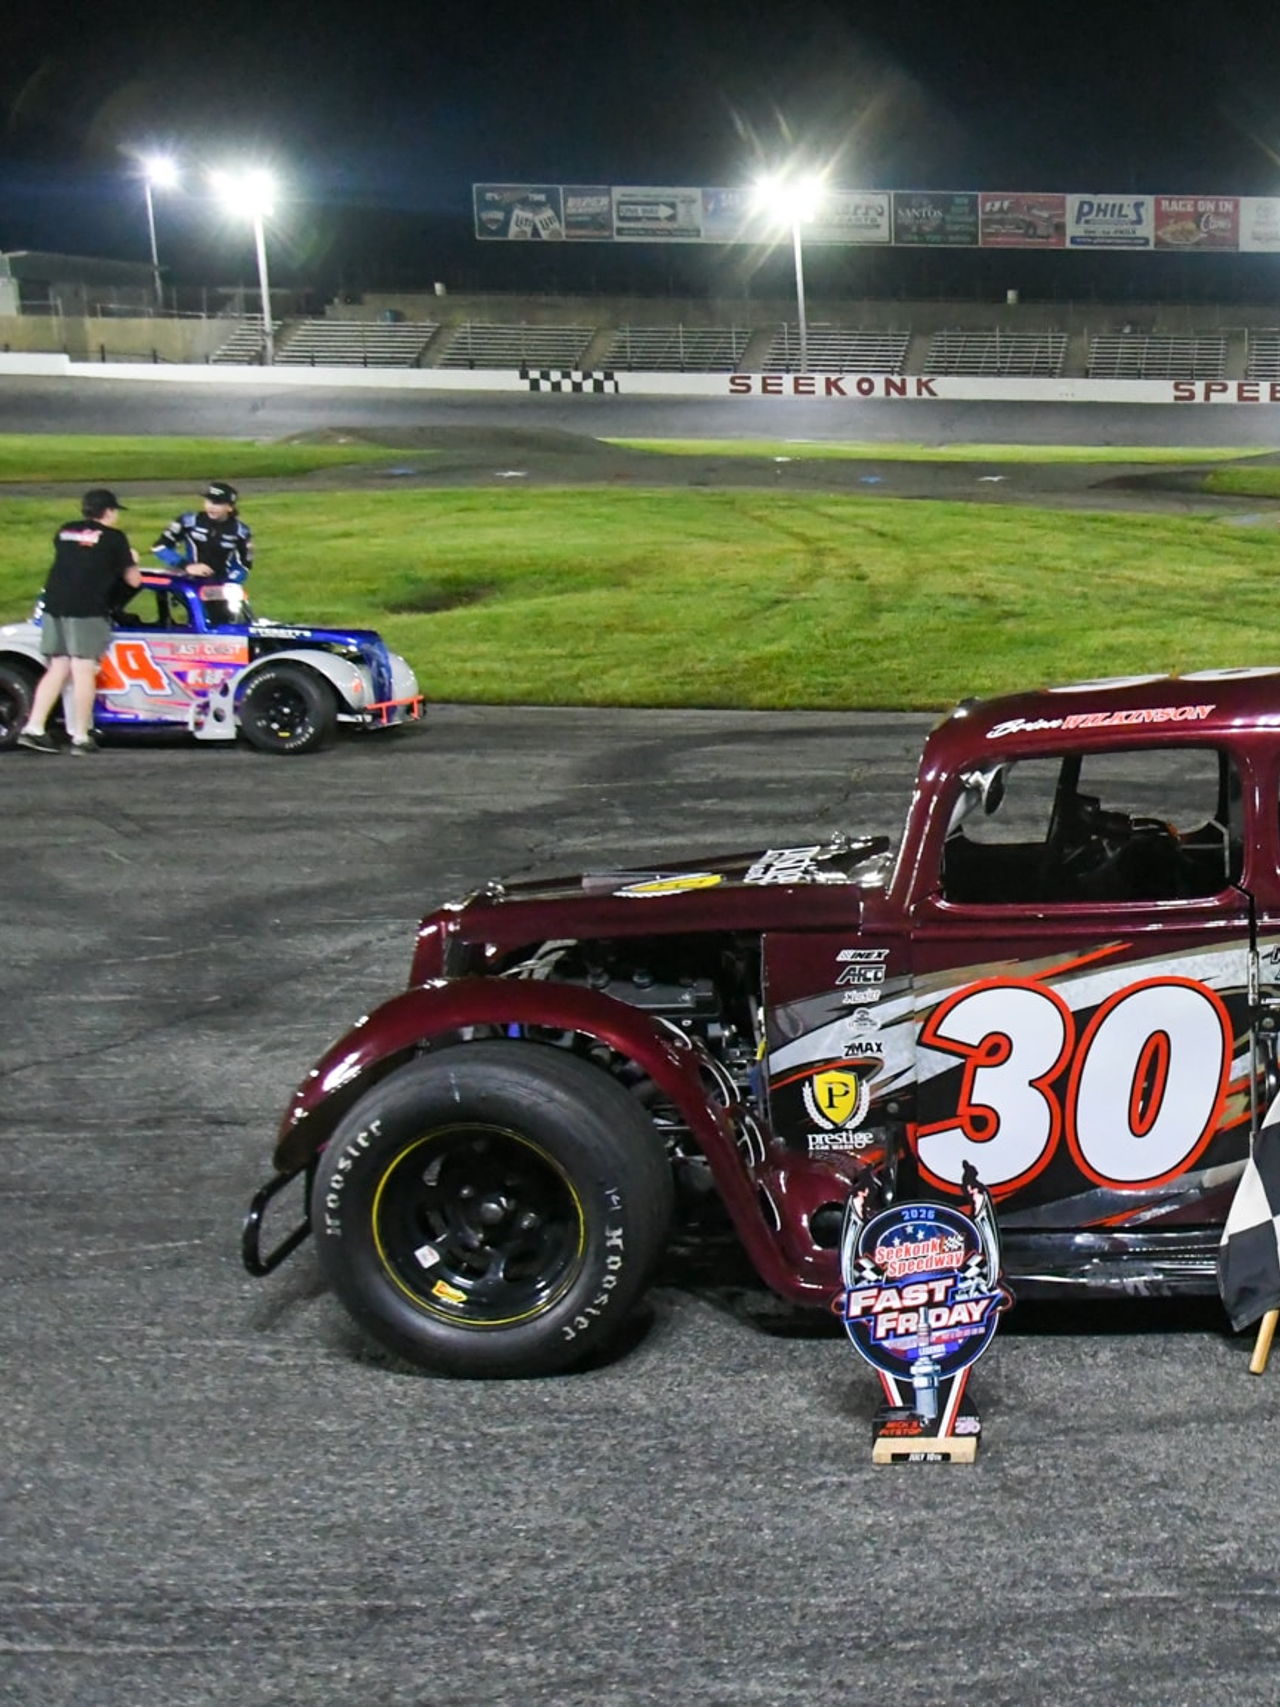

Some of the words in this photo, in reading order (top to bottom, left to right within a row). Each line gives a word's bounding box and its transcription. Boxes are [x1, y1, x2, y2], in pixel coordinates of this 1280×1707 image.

[897, 207, 943, 218] SANTOS
[1075, 200, 1145, 225] PHIL'S
[1160, 200, 1194, 212] RACE
[1218, 201, 1234, 213] IN
[728, 375, 938, 397] SEEKONK
[1061, 704, 1216, 730] WILKINSON
[850, 950, 886, 960] INEX
[823, 1080, 851, 1109] P
[906, 976, 1236, 1197] 30
[807, 1130, 874, 1150] prestige
[901, 1208, 936, 1221] 2026
[875, 1237, 940, 1264] Seekonk
[887, 1250, 965, 1277] Speedway
[848, 1278, 955, 1318] FAST
